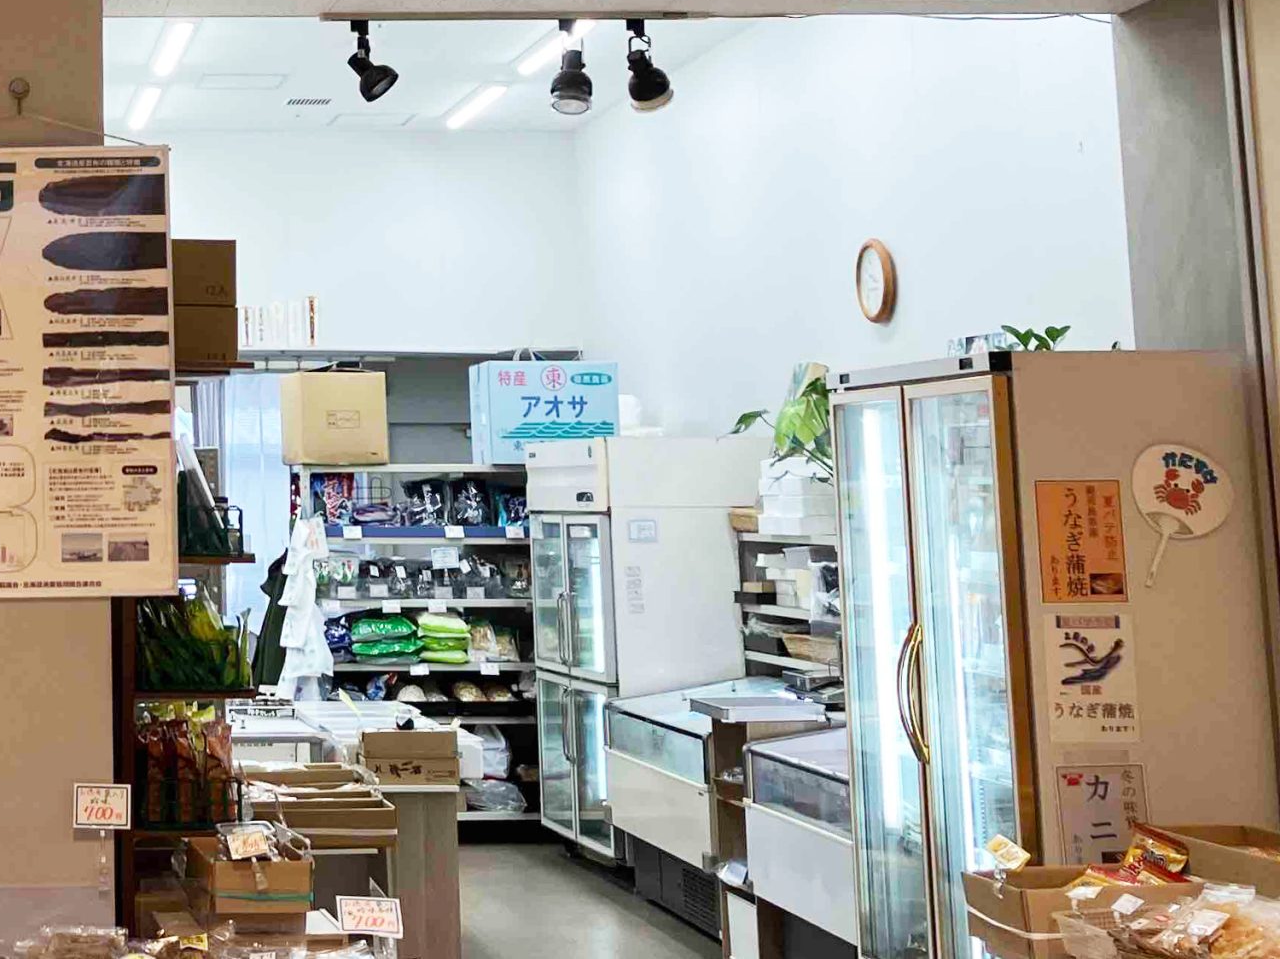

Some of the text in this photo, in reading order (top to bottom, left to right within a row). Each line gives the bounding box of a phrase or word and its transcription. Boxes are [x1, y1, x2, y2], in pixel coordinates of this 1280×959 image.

[498, 370, 528, 387] 特産
[545, 368, 561, 388] 東
[521, 395, 588, 418] アオサ
[1064, 487, 1088, 597] うなぎ蒲焼
[1054, 702, 1134, 719] うなぎ蒲焼
[1086, 775, 1117, 839] カニ
